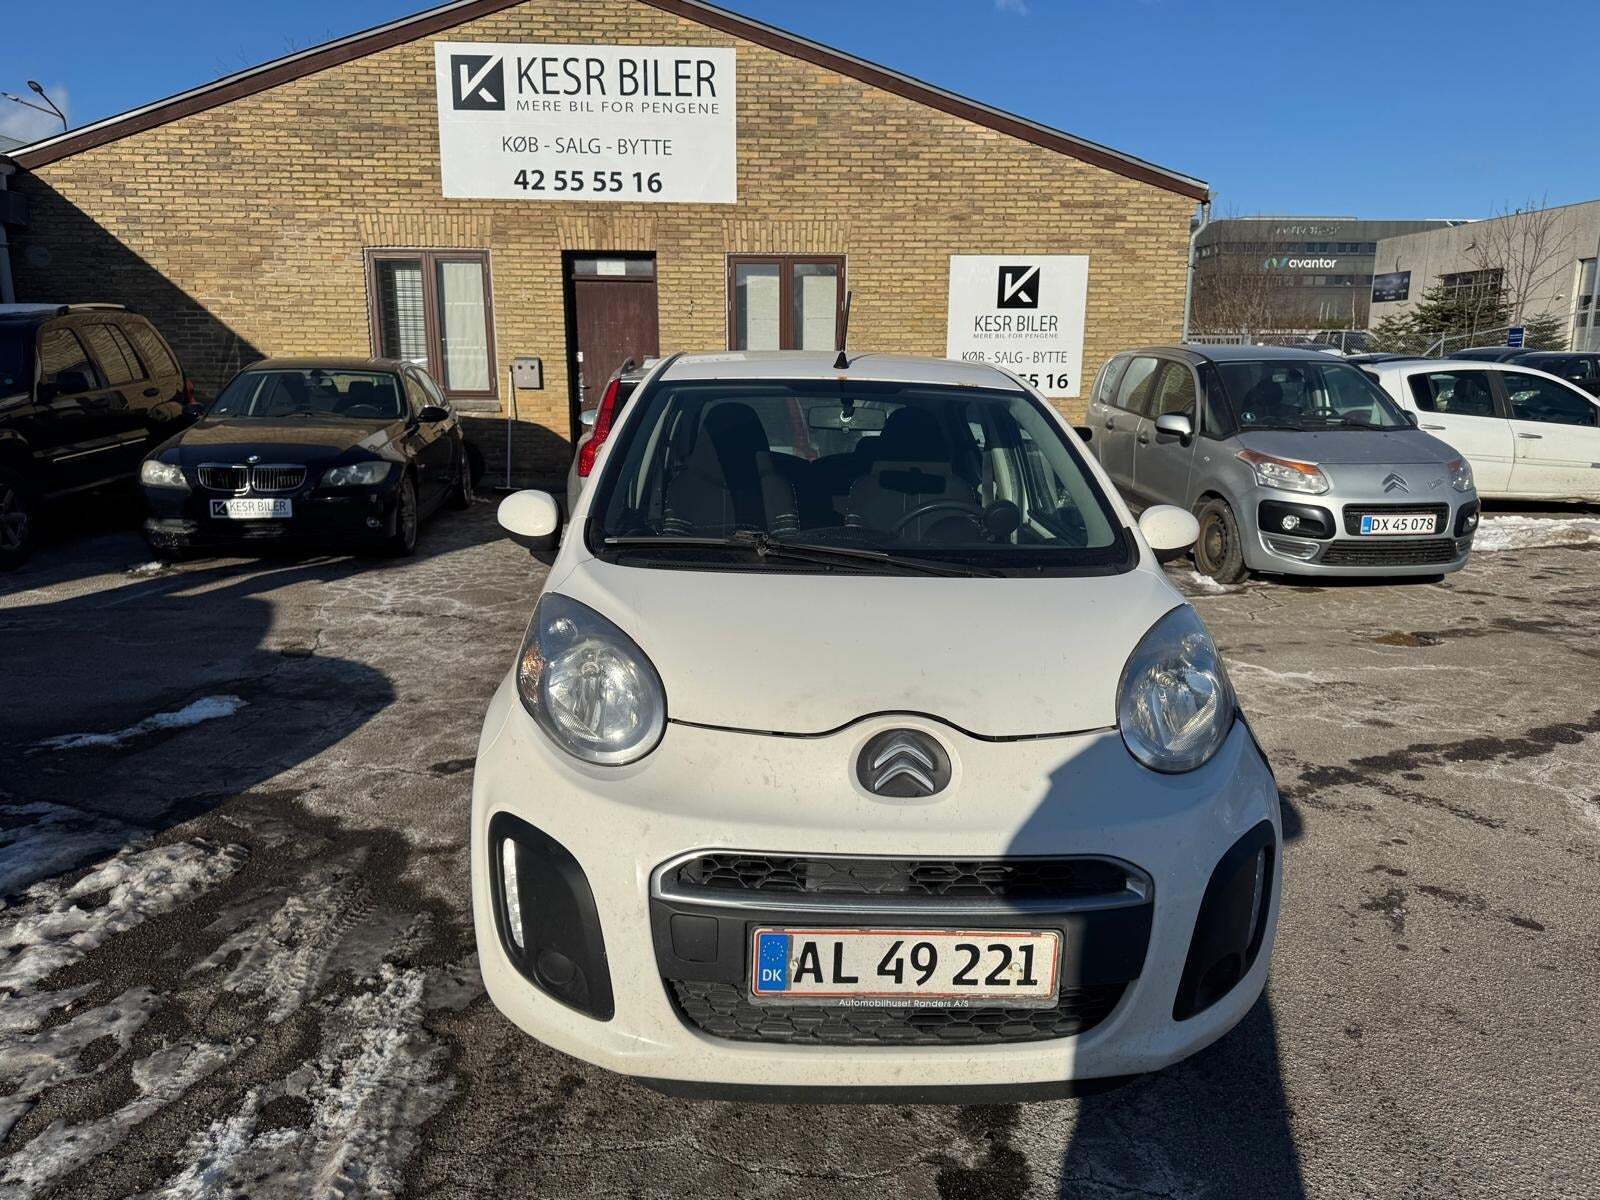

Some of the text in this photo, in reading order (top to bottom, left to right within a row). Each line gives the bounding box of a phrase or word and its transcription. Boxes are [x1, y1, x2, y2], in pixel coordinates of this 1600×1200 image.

[516, 56, 717, 98] KESR BILER
[516, 100, 720, 114] MERE BIL FOR PENGENE
[502, 136, 539, 153] KØB
[555, 137, 601, 154] SALG
[617, 139, 673, 156] BYTTE
[514, 169, 663, 193] 42 55 55 16
[1289, 257, 1337, 269] avantor
[974, 315, 1058, 332] KESR BILER
[994, 351, 1023, 363] SALG
[1032, 351, 1068, 363] BYTTE
[1018, 374, 1068, 389] 5 16
[230, 501, 286, 511] KESR BILER
[1372, 517, 1434, 531] DX 45 078
[793, 941, 1039, 986] AL 49 221
[762, 969, 782, 983] DK
[839, 999, 969, 1008] Automobilhuset Randers A/S
